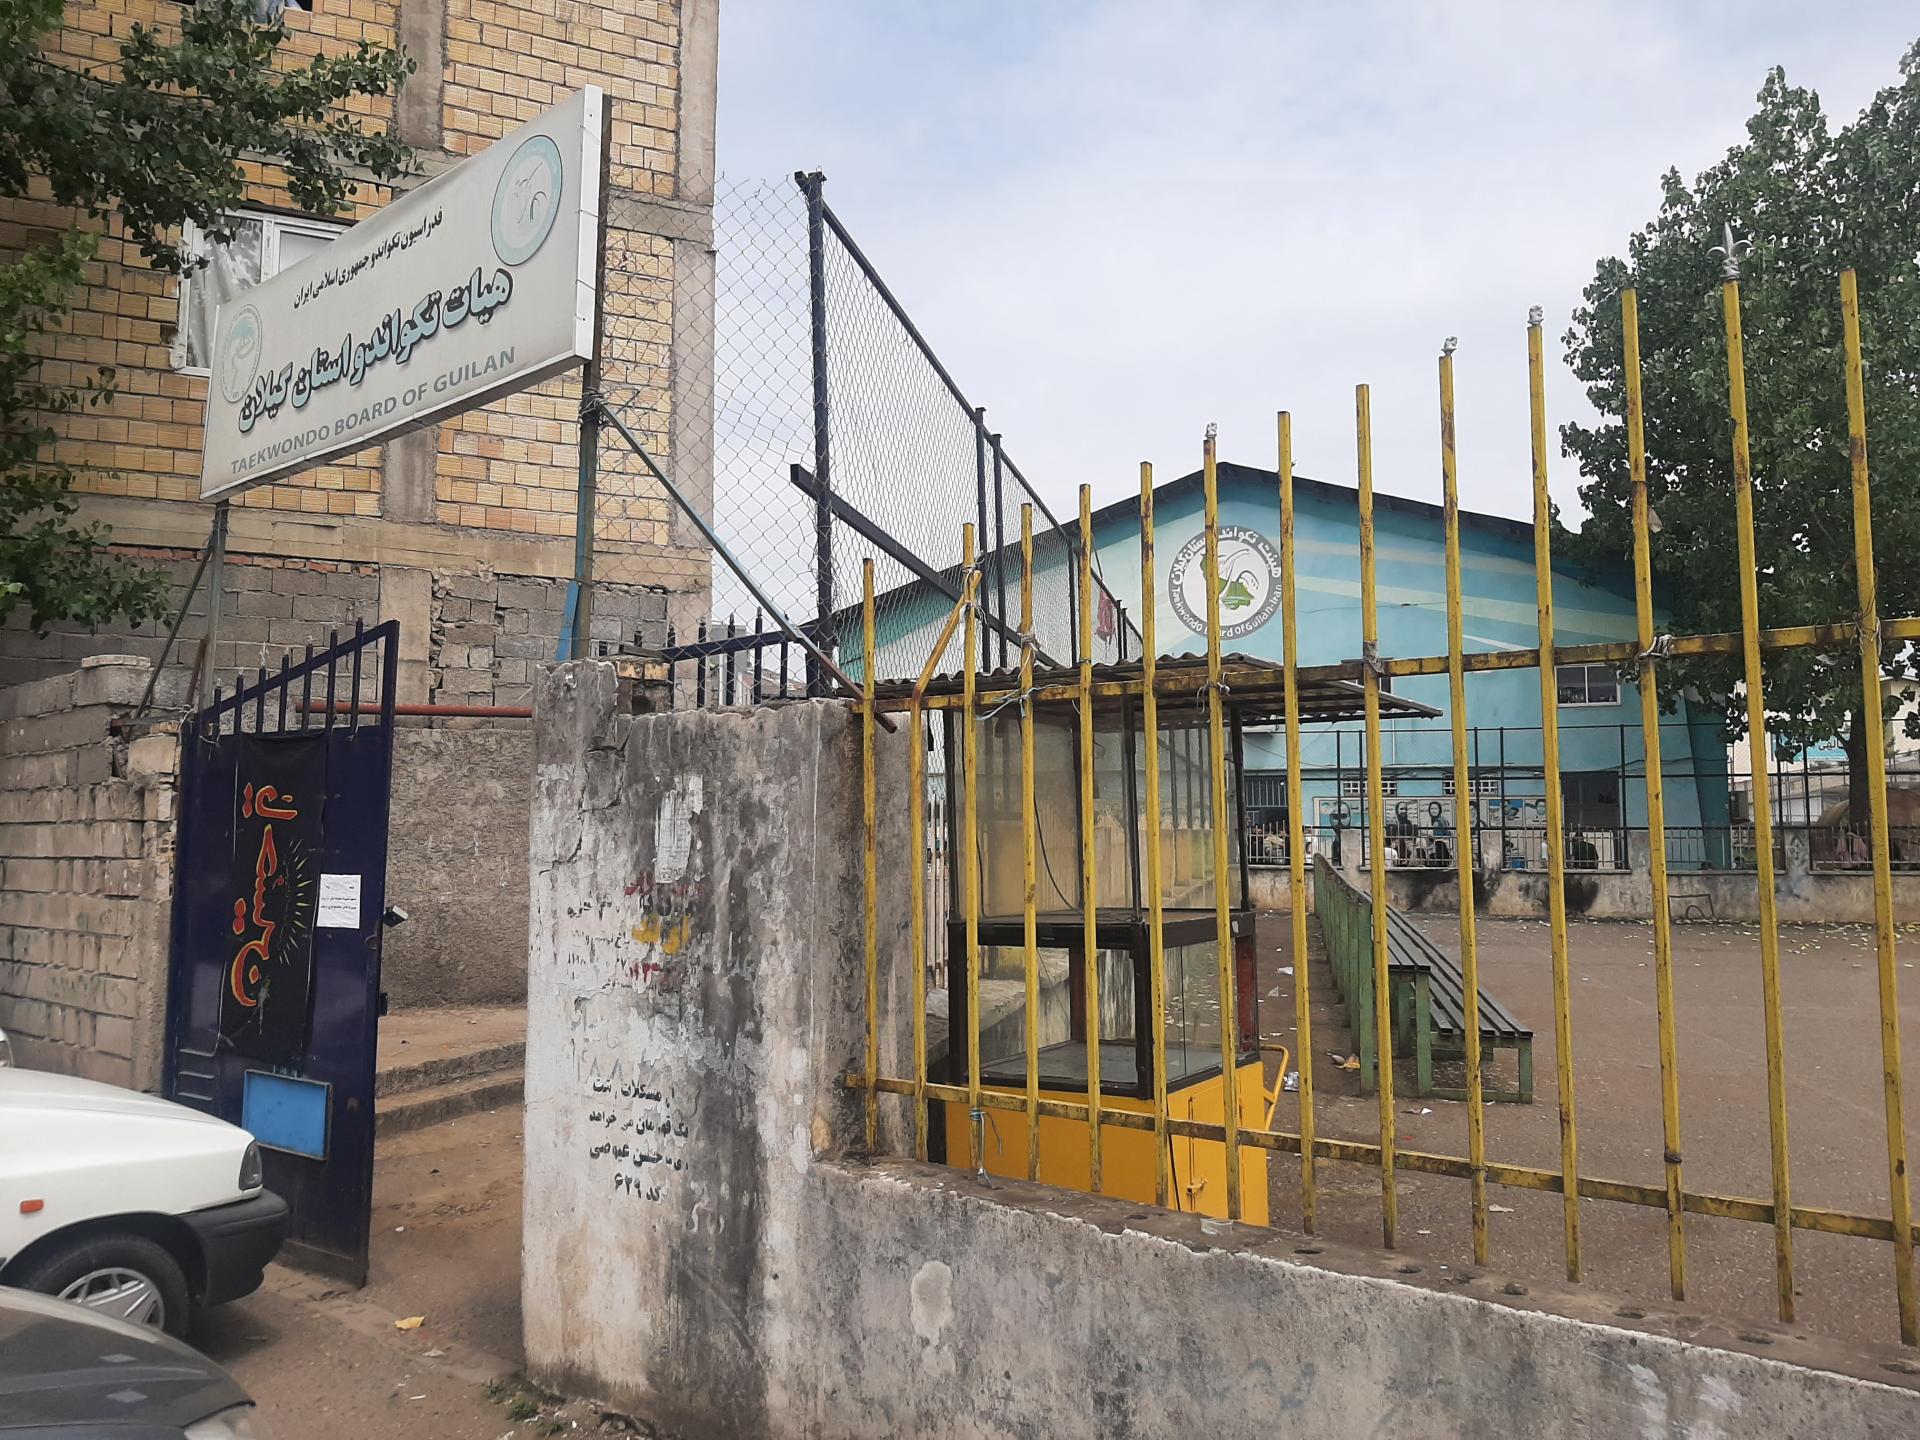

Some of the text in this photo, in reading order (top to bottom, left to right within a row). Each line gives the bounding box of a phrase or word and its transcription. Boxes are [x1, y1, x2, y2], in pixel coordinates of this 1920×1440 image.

[293, 206, 443, 309] فدراسیون تکواندو جمهوری اسلامی ایران
[291, 333, 352, 409] استان
[349, 290, 443, 387] تکواندو
[231, 346, 515, 475] TAEKWONDO BOARD OF GUILAN
[238, 362, 294, 433] گیلان
[1219, 526, 1260, 544] تکواند
[1171, 587, 1203, 632] Taekwondo
